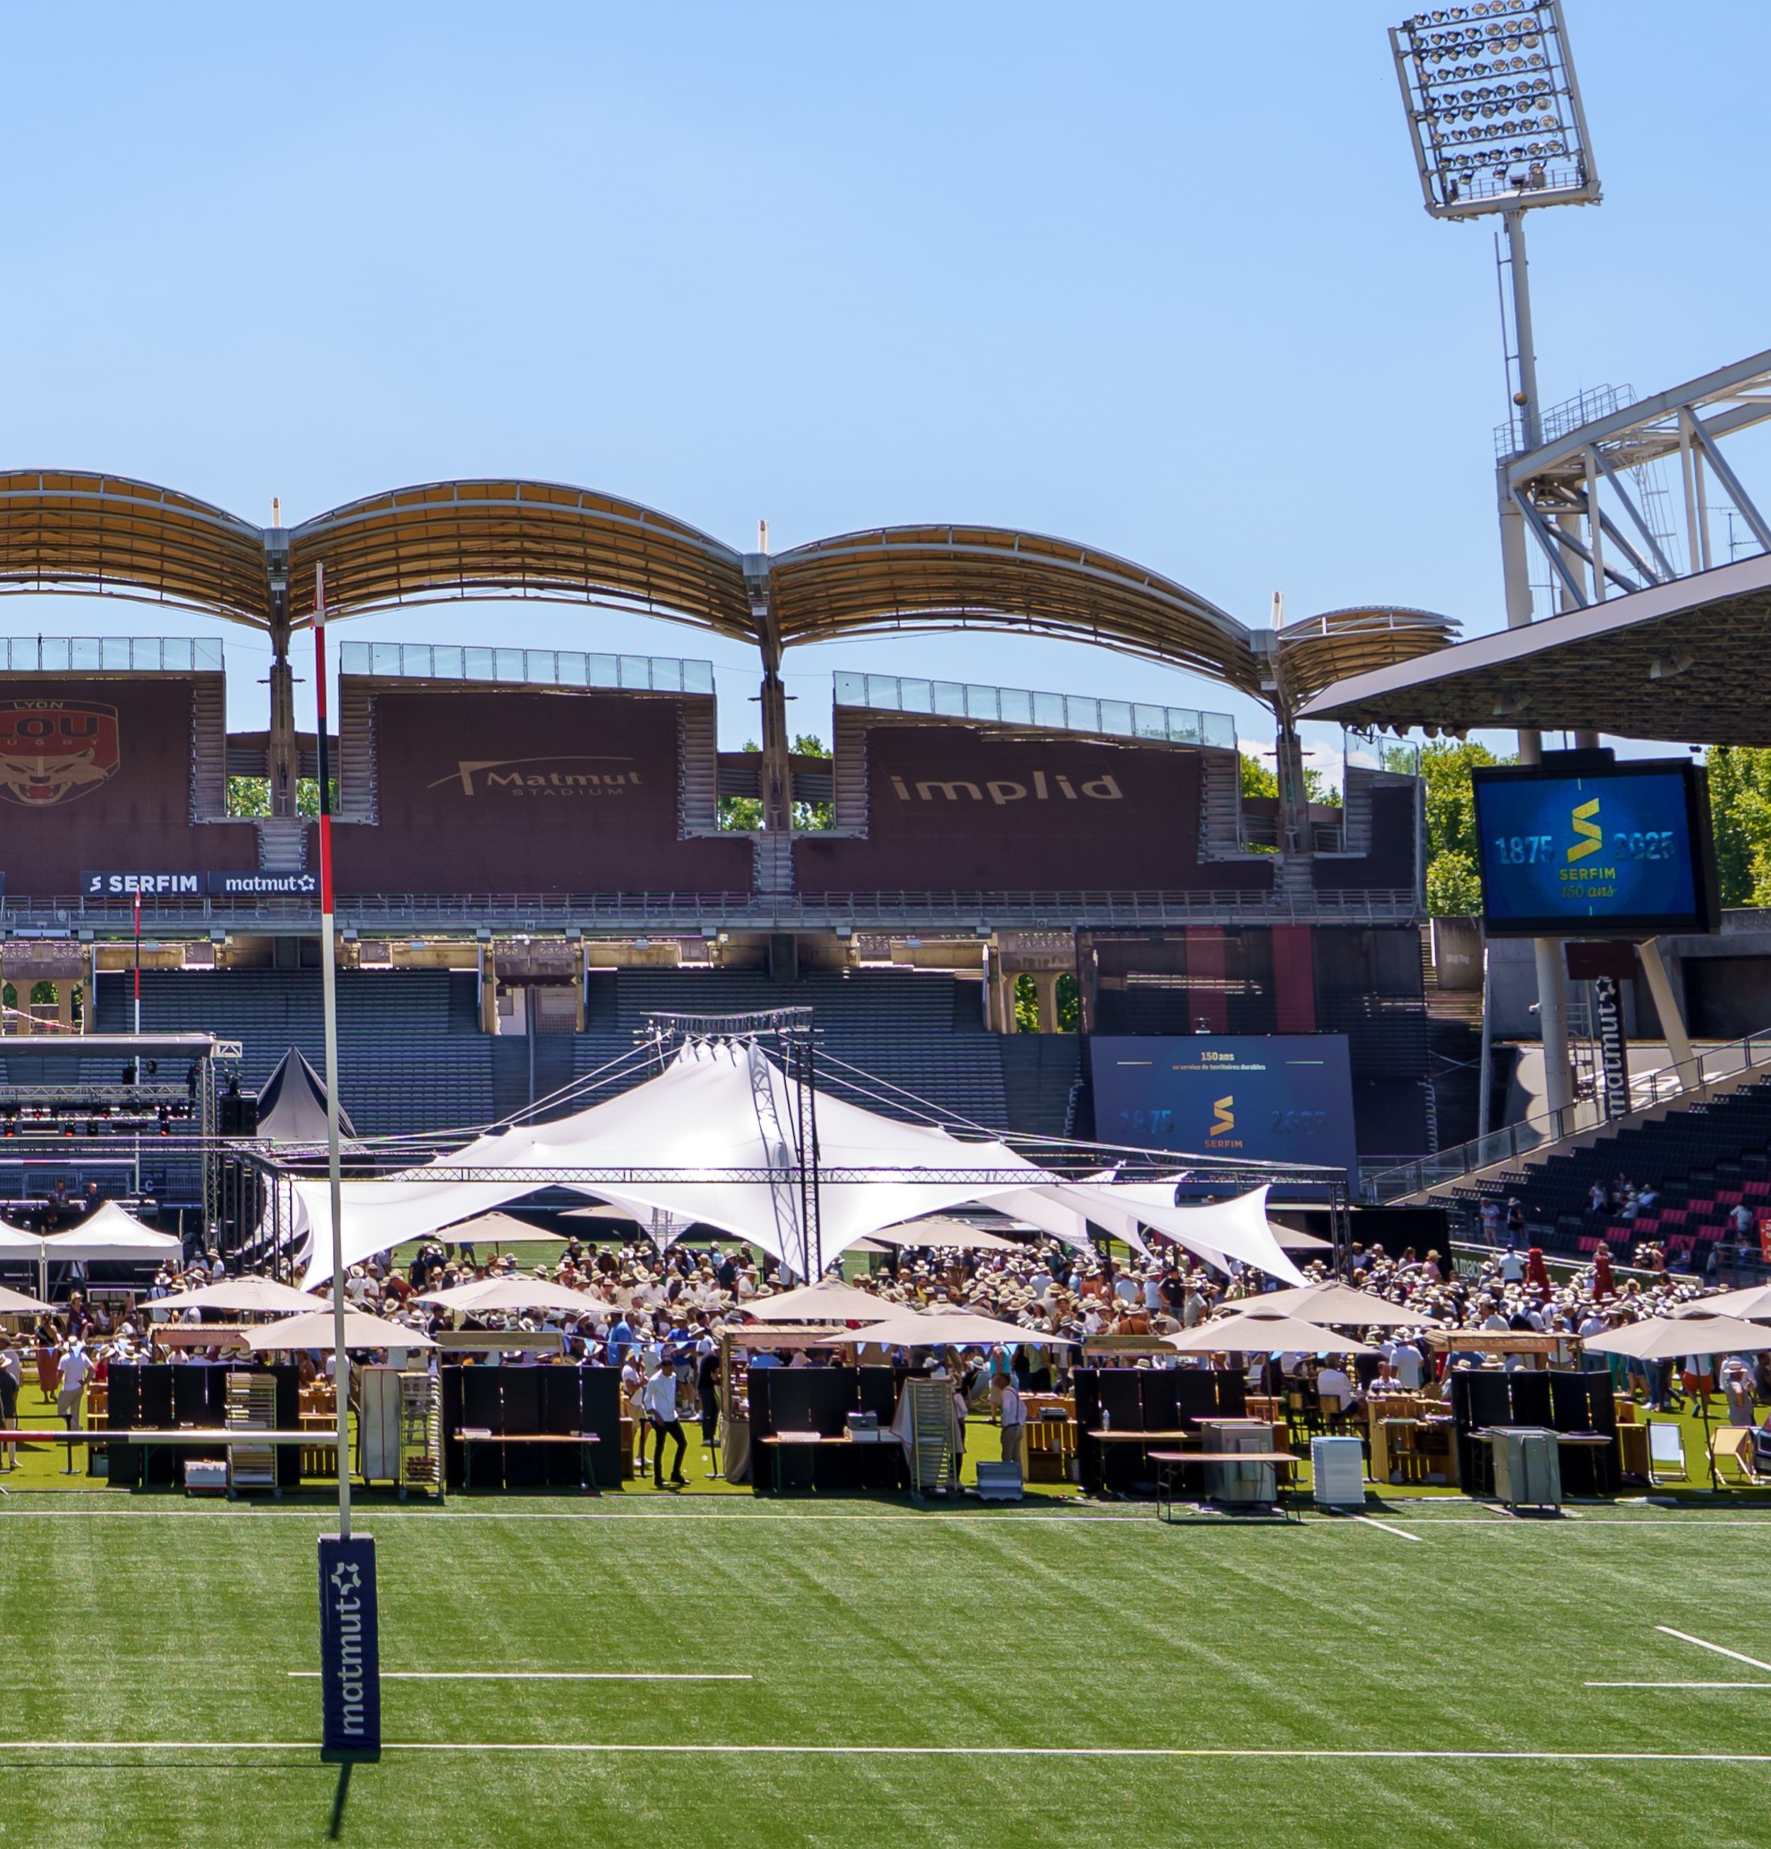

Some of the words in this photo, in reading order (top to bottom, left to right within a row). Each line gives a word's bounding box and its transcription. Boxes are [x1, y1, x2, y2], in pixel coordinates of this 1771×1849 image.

[13, 701, 64, 709] LYON
[486, 771, 644, 786] Matmut
[511, 788, 624, 796] STADIUM
[890, 770, 1124, 805] implid
[1495, 835, 1555, 864] 1875
[1614, 831, 1675, 862] 2025
[1559, 867, 1616, 880] SERFIM
[109, 875, 197, 892] SERFIM
[226, 875, 298, 892] matmut
[1587, 884, 1617, 897] ans
[1201, 1052, 1218, 1061] 150
[1219, 1053, 1234, 1061] ans
[1598, 1002, 1626, 1119] matmut
[1204, 1139, 1243, 1148] SERFIM
[335, 1596, 365, 1735] matmut
